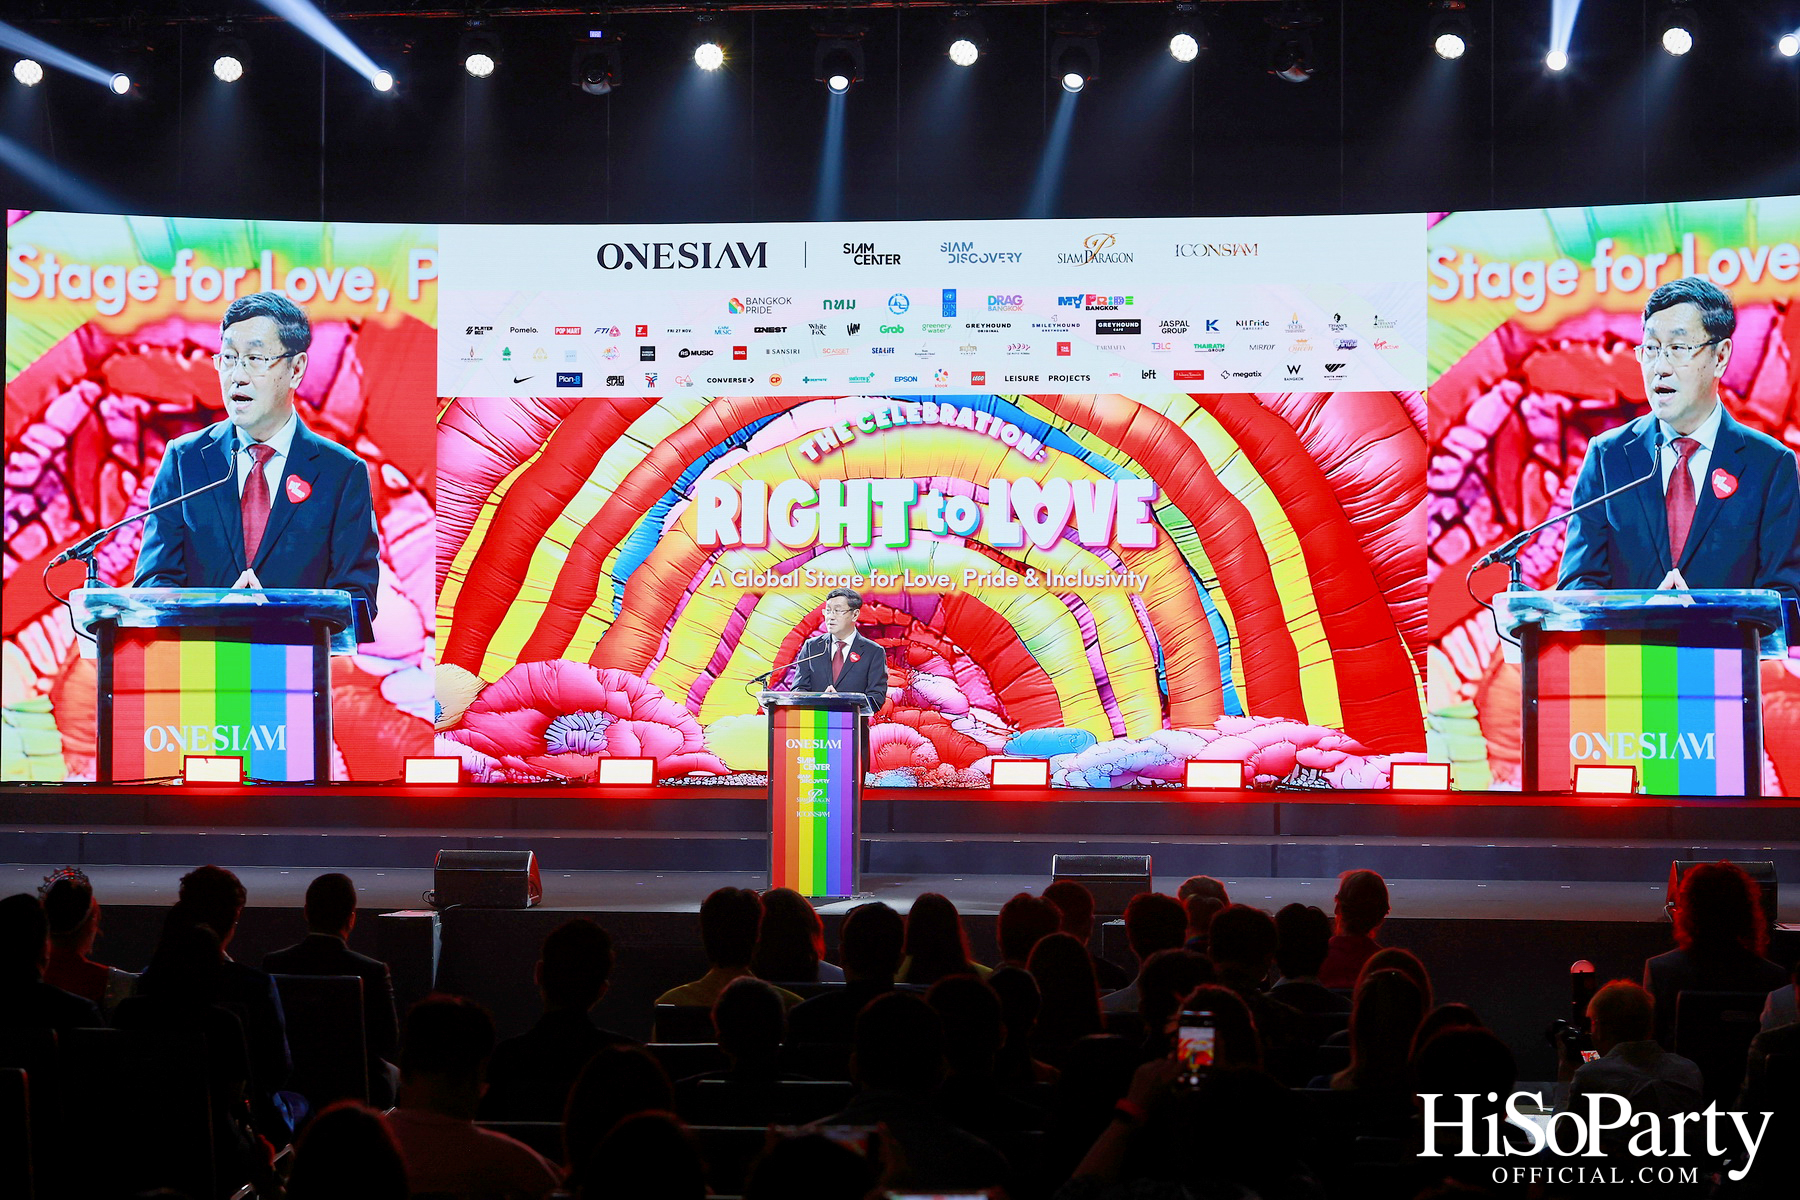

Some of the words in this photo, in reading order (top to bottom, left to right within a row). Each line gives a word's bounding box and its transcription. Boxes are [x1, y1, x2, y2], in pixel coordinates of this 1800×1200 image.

[843, 242, 875, 254] SIAM
[940, 242, 974, 252] SIAM
[1175, 243, 1258, 257] ICONSIAM
[853, 254, 901, 265] CENTER
[948, 253, 1022, 263] DISCOVERY
[1428, 246, 1580, 313] Stage
[1592, 236, 1668, 293] for
[1682, 232, 1800, 287] Love
[8, 243, 159, 316] Stage
[172, 248, 247, 302] for
[260, 249, 391, 312] Love,
[745, 297, 792, 305] BANGKOK
[823, 299, 856, 310] กทม
[988, 295, 1023, 306] DRAG
[745, 306, 772, 314] PRIDE
[880, 325, 905, 334] Grab
[1232, 370, 1262, 378] megatix
[1286, 364, 1301, 375] W
[1048, 375, 1091, 383] PROJECTS
[798, 420, 855, 463] THE
[696, 477, 918, 550] RIGHT
[930, 487, 981, 536] to
[988, 476, 1159, 550] LOVE
[710, 569, 726, 587] A
[730, 568, 800, 588] Global
[804, 569, 864, 588] Stage
[869, 569, 899, 587] for
[904, 569, 957, 590] Love,
[963, 568, 1018, 587] Pride
[1024, 569, 1039, 587] &
[1046, 568, 1149, 591] Inclusivity
